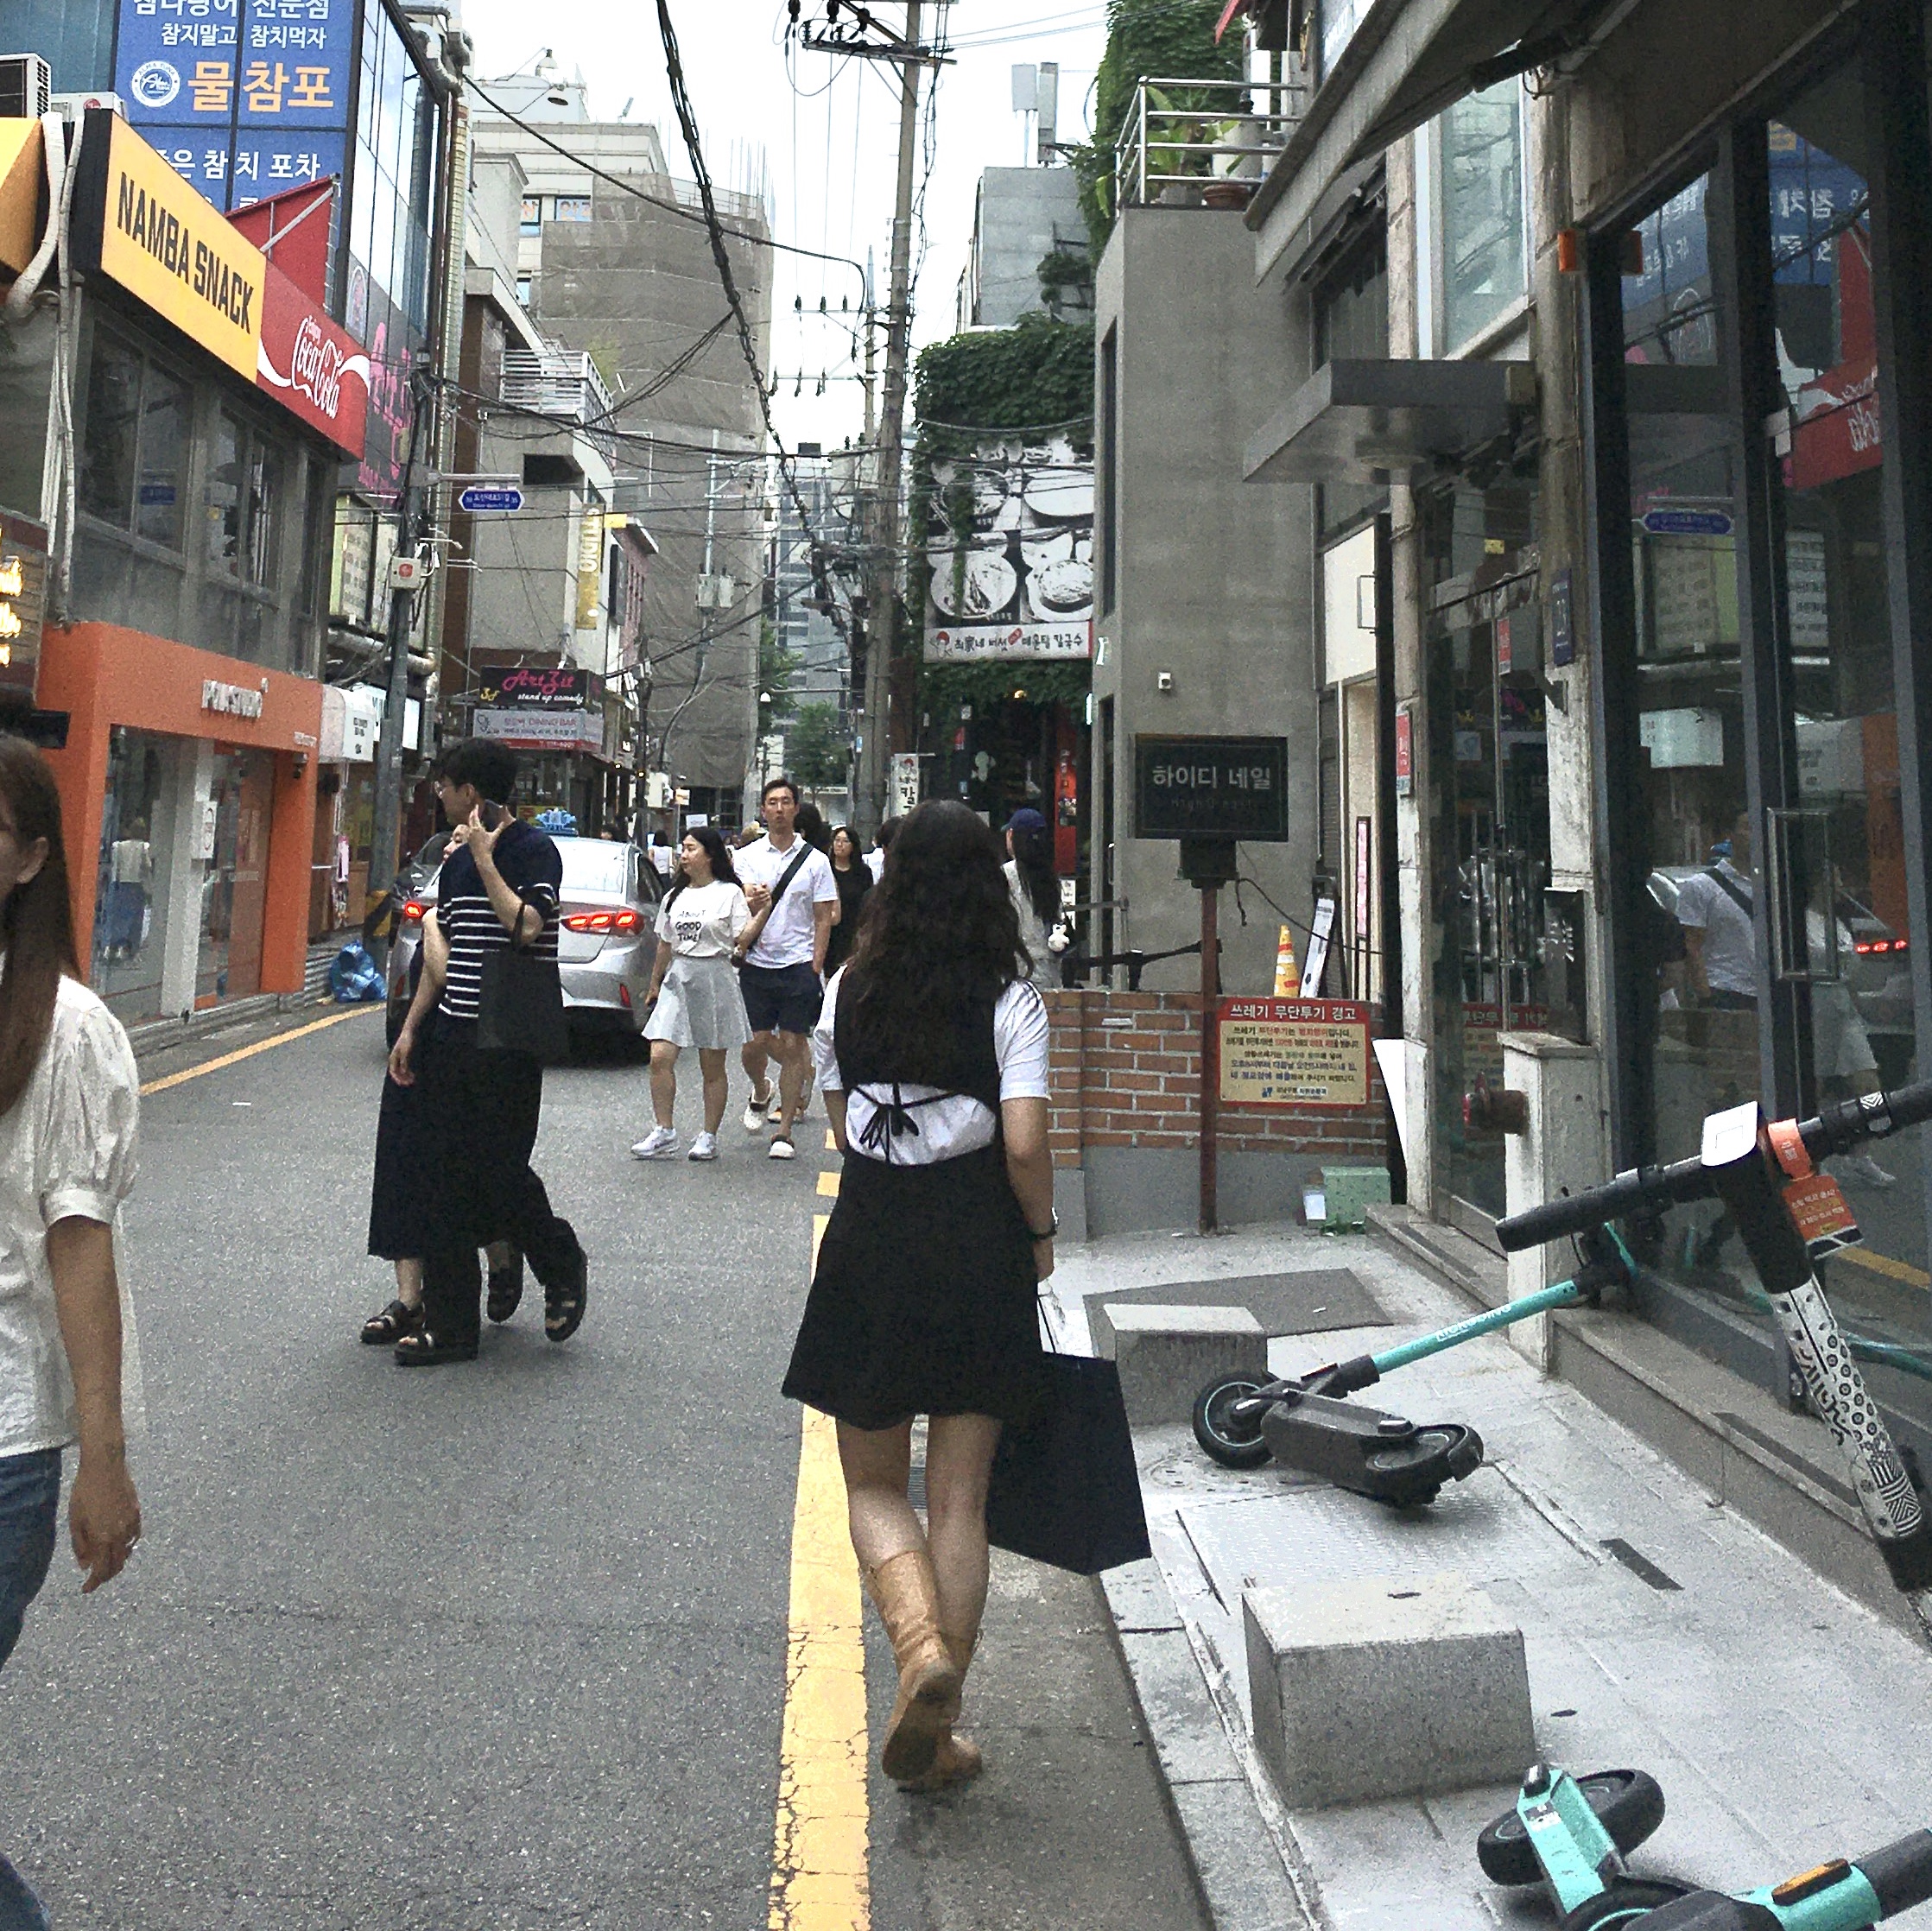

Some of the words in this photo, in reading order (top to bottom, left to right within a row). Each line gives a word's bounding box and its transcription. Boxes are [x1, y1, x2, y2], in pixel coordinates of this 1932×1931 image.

[162, 22, 238, 47] 참지말고
[250, 25, 326, 49] 참치먹자
[268, 153, 321, 181] 포차
[117, 171, 189, 285] NAMBA
[193, 240, 254, 334] SNACK
[1054, 633, 1083, 649] 칼국수
[517, 692, 540, 701] stand
[542, 695, 553, 704] up
[554, 693, 584, 706] comedy
[1152, 765, 1217, 789] 하이디
[1228, 766, 1271, 790] 네일
[675, 921, 701, 931] GOOD
[1230, 1004, 1269, 1019] 쓰레기
[1274, 1005, 1325, 1021] 무단투기
[1332, 1006, 1357, 1021] 경고
